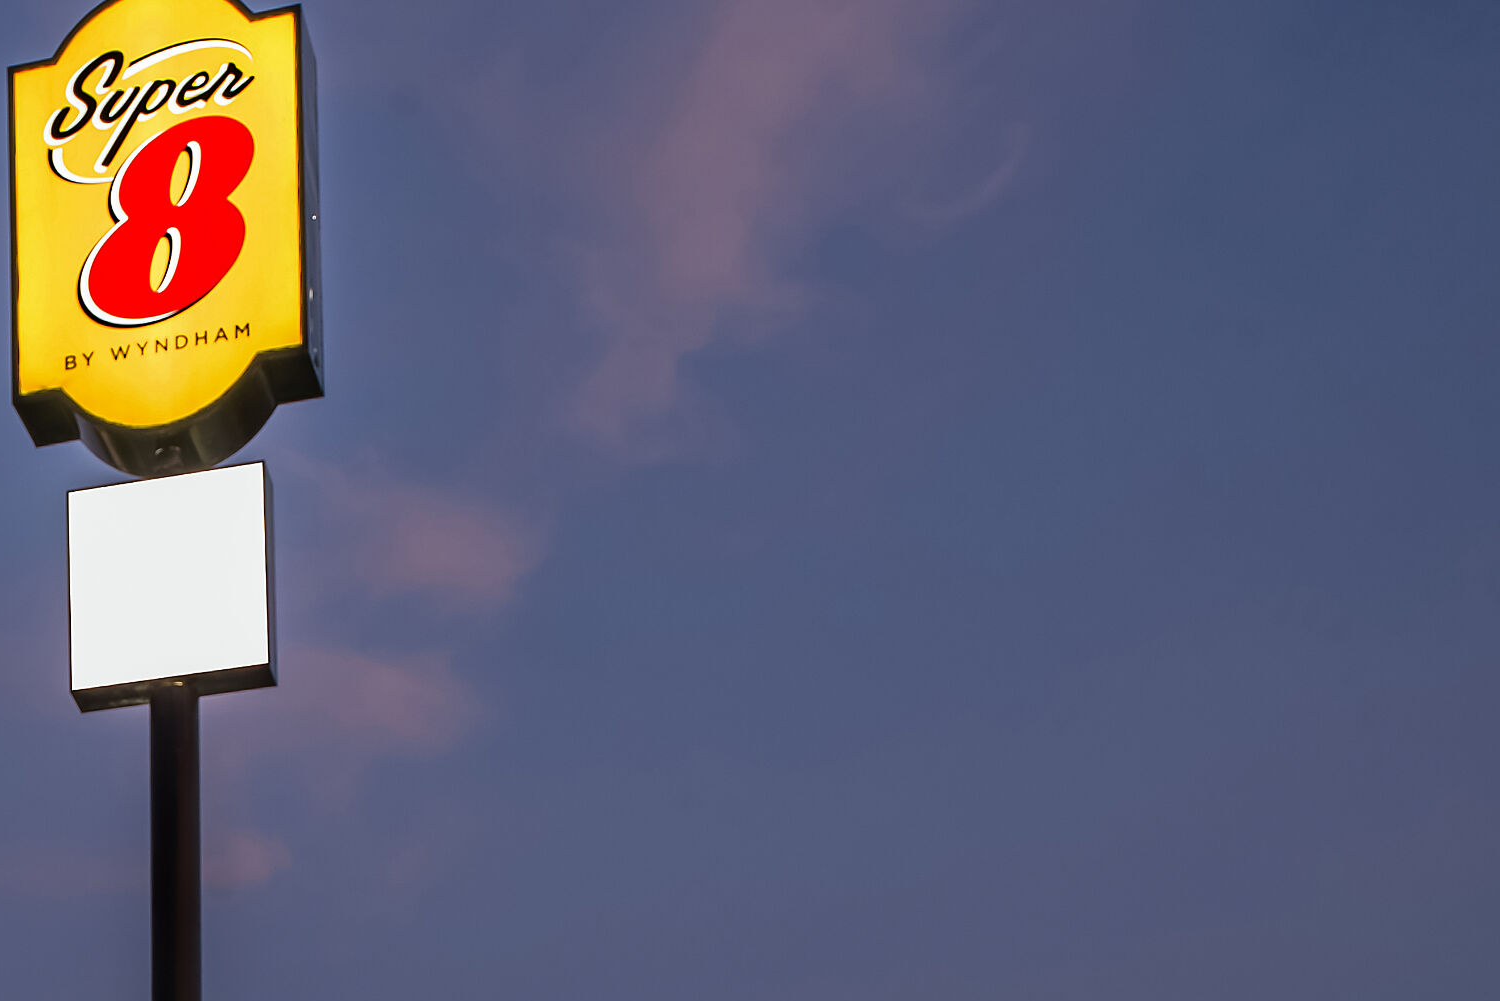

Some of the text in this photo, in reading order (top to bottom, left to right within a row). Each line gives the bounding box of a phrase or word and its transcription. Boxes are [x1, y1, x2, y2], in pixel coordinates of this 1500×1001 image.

[45, 50, 254, 172] Super
[77, 115, 255, 328] 8
[64, 322, 250, 370] BY WYNDHAM
